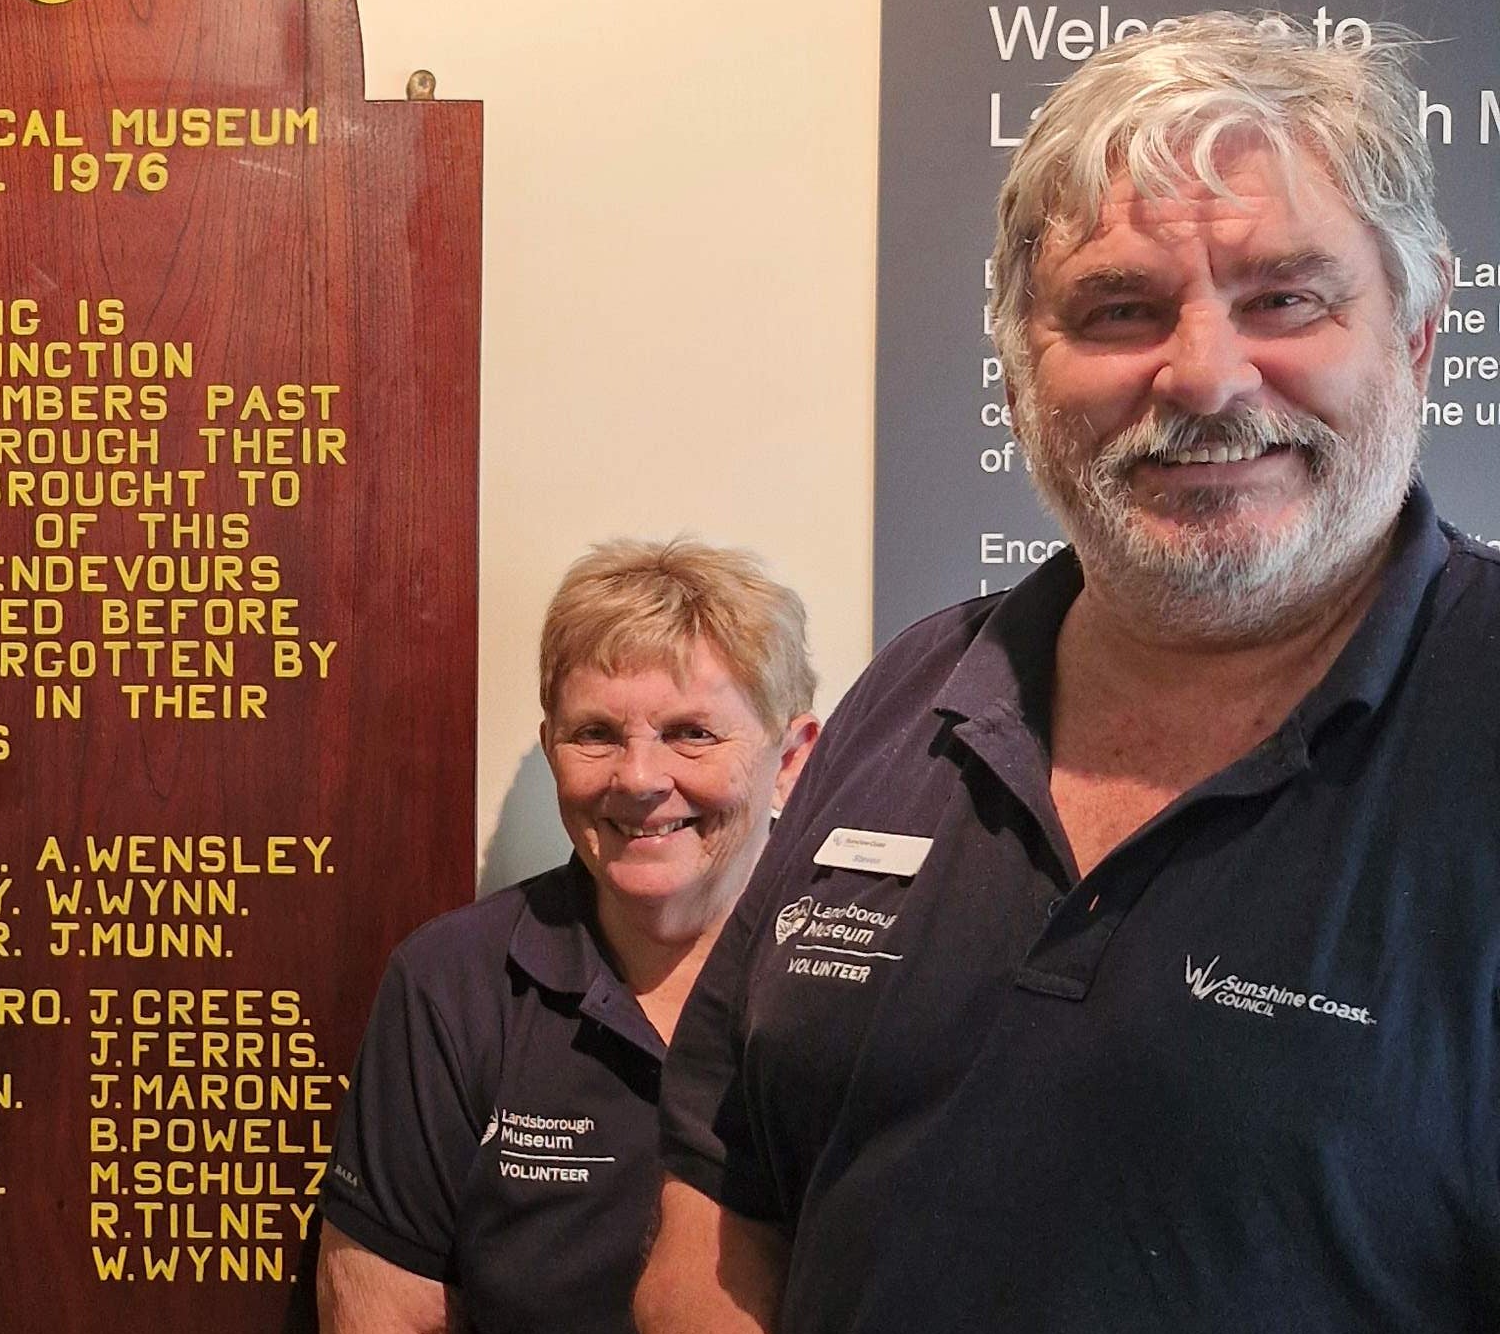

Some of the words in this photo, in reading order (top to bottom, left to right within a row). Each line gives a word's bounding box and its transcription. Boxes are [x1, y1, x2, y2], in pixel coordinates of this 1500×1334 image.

[1313, 6, 1373, 53] to
[112, 108, 319, 149] MUSEUM
[53, 153, 168, 193] 1976
[79, 299, 125, 336] IS
[207, 383, 339, 421] PAST
[201, 426, 346, 465] THEIR
[980, 441, 1015, 473] of
[240, 470, 301, 507] TO
[38, 511, 94, 549] OF
[141, 511, 250, 549] THIS
[102, 597, 300, 636] BEFORE
[274, 641, 337, 678] BY
[35, 684, 82, 720] IN
[123, 684, 269, 720] THEIR
[38, 834, 335, 875] A.WENSLEY.
[47, 877, 249, 916] W.WYNN.
[50, 920, 233, 958] J.MUNN.
[786, 956, 872, 983] VOLUNTEER
[91, 989, 312, 1026] J.CREES.
[1213, 990, 1275, 1018] COUNCIL
[1221, 974, 1307, 1008] Sunshine
[90, 1031, 326, 1068] J.FERRIS.
[500, 1126, 574, 1150] Museum
[501, 1108, 595, 1134] Landsborough
[499, 1160, 590, 1183] VOLUNTEER
[91, 1244, 297, 1282] W.WYNN.
